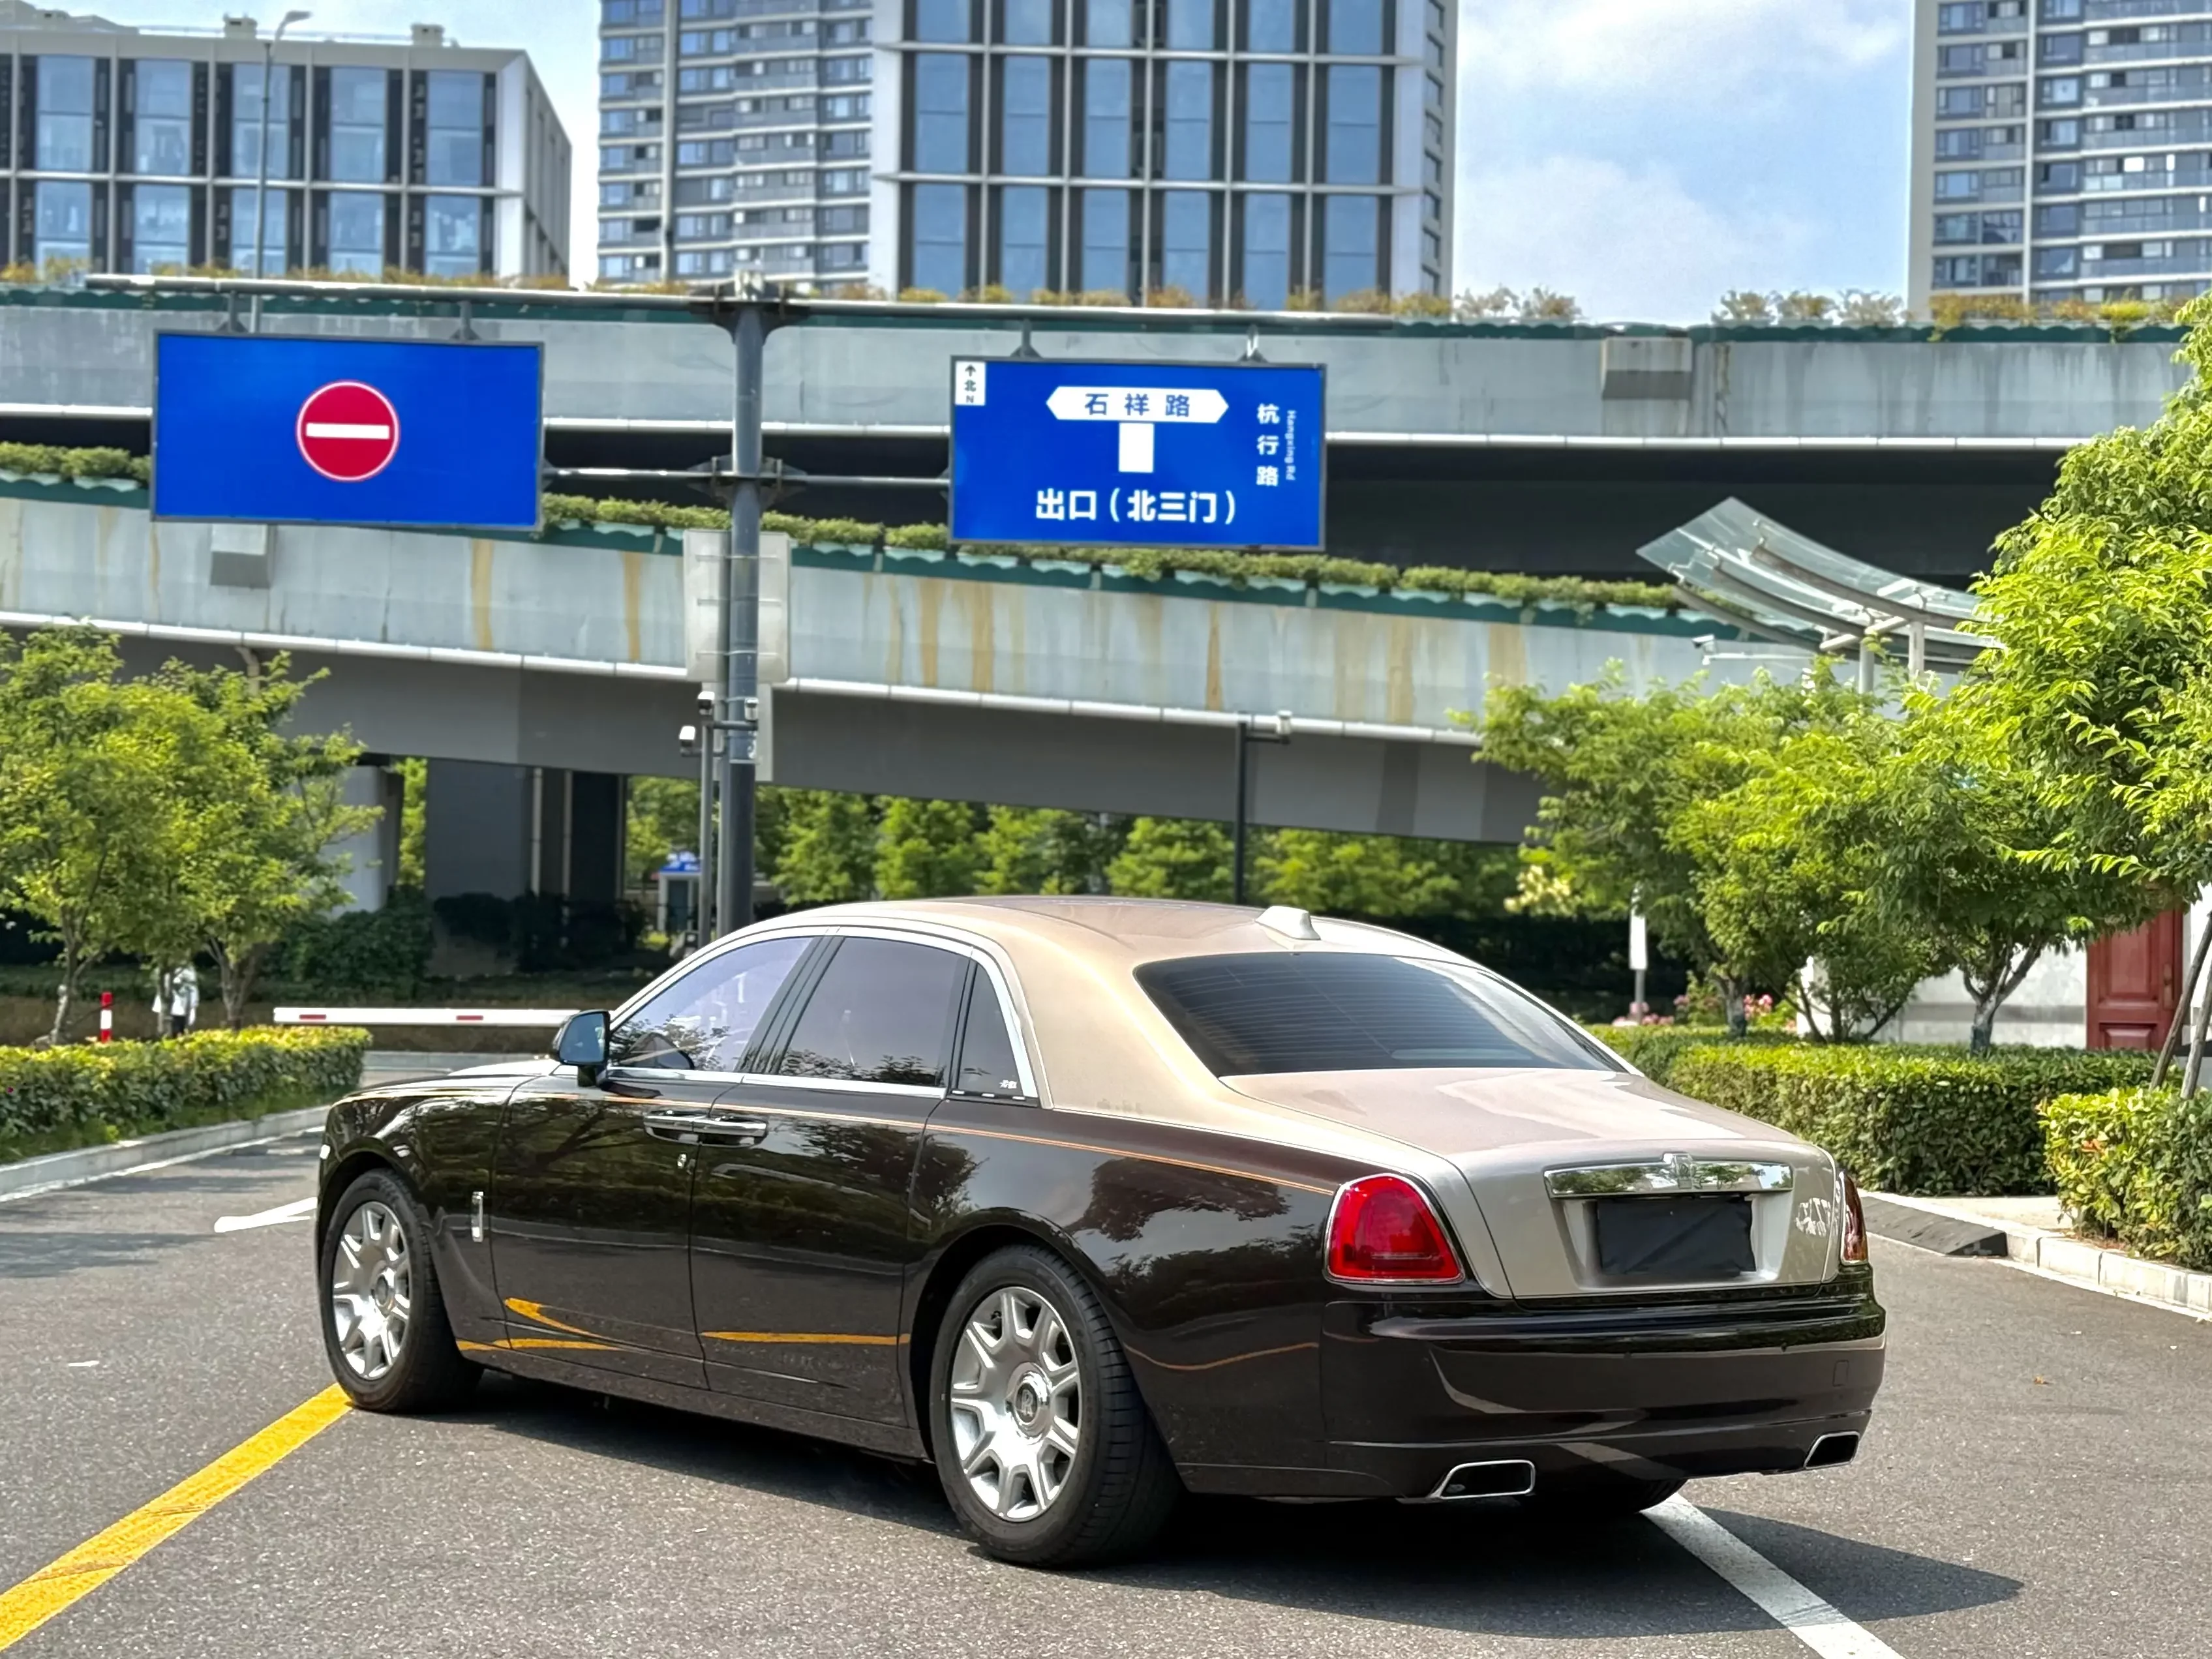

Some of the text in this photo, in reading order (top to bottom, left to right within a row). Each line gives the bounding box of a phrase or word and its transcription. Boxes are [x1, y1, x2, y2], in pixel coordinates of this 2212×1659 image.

[964, 380, 977, 392] 北
[965, 395, 975, 403] N
[1084, 393, 1190, 417] 石祥路
[1256, 402, 1280, 486] 杭行路
[1286, 465, 1296, 481] Rd
[1036, 488, 1235, 524] 出口（北三门）
